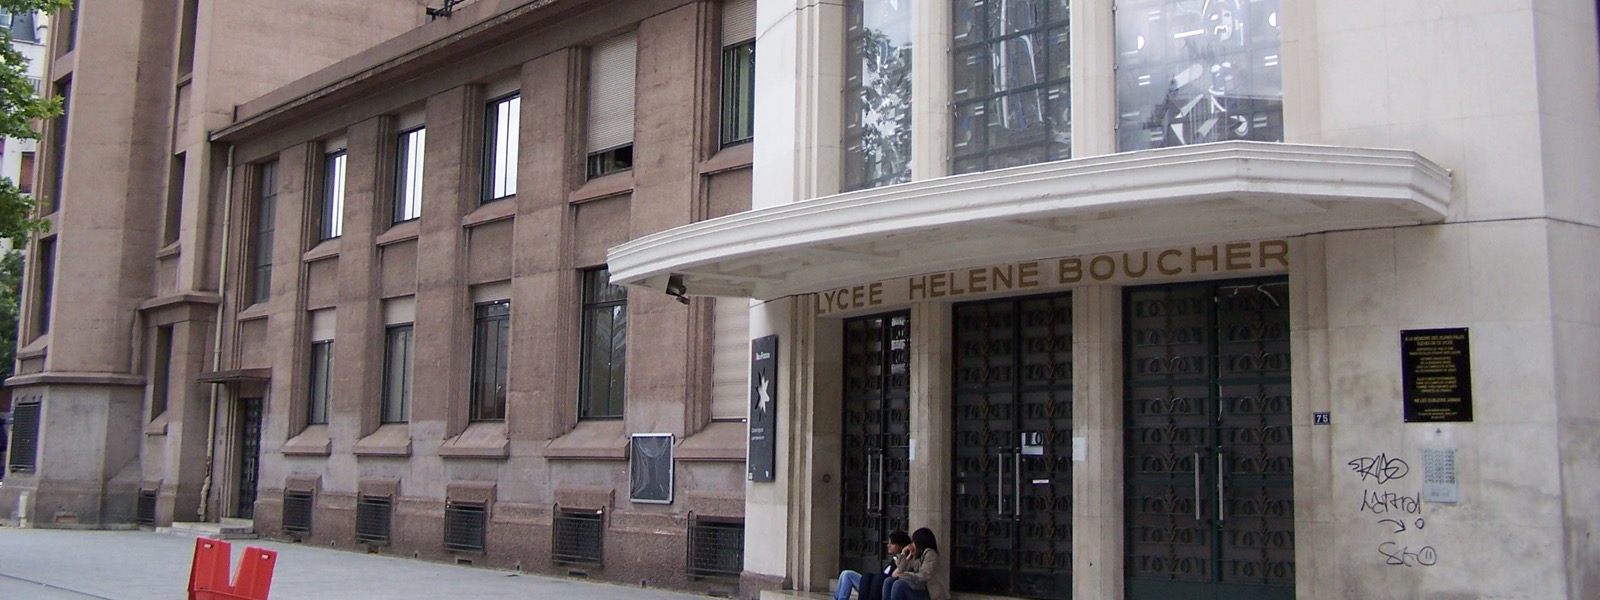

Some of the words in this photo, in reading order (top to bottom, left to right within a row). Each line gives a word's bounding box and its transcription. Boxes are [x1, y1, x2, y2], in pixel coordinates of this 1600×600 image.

[816, 282, 883, 314] LYCEE
[909, 261, 1039, 300] HELENE
[1059, 240, 1289, 284] BOUCHER
[1316, 414, 1328, 423] 75
